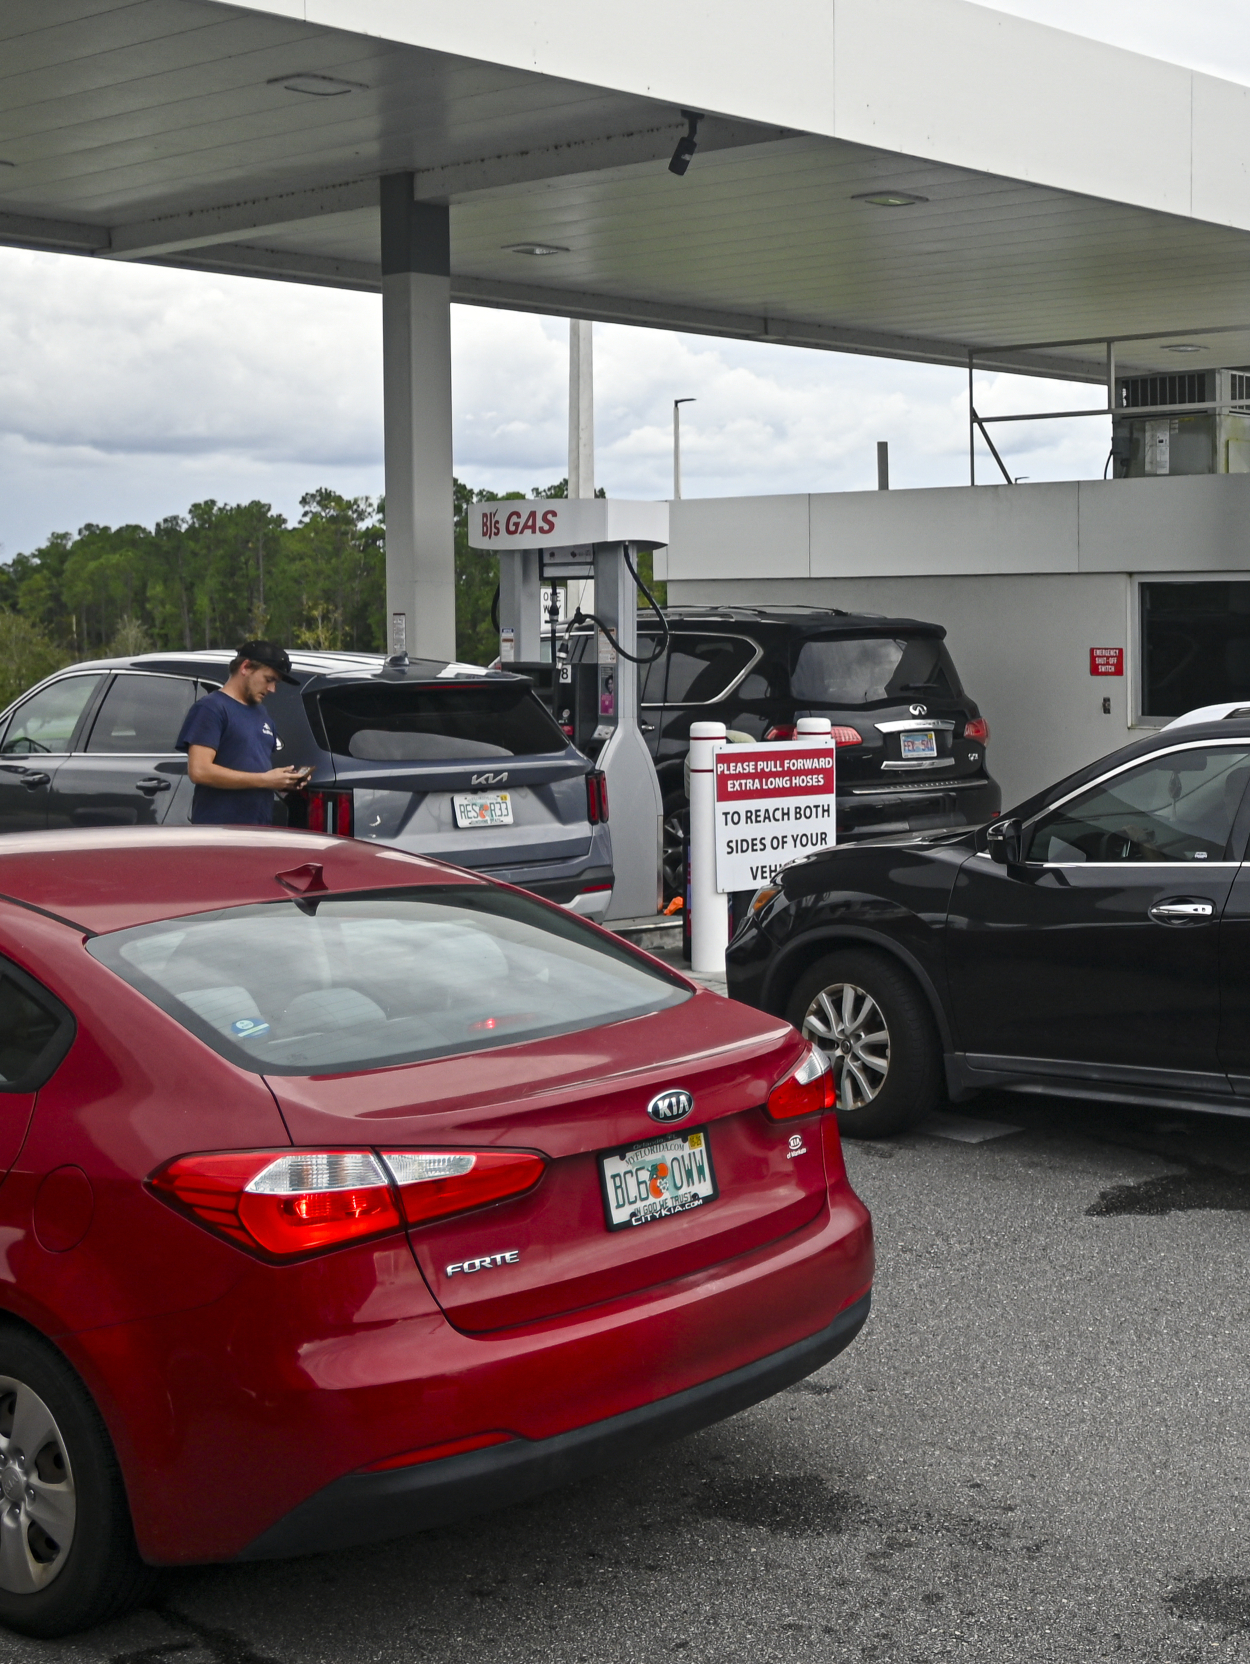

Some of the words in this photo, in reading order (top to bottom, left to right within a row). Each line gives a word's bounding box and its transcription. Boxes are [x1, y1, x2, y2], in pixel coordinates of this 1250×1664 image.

[482, 508, 500, 540] BJ's
[505, 509, 558, 535] GAS
[543, 591, 561, 601] OE
[1093, 648, 1119, 656] EMERGENCY
[561, 667, 569, 680] 8
[717, 762, 755, 775] PLEASE
[757, 760, 782, 772] PULL
[784, 757, 833, 771] FORWARD
[727, 778, 760, 792] EXTRA
[762, 777, 790, 789] LONG
[792, 774, 824, 787] HOSES
[459, 803, 479, 820] RES
[489, 801, 509, 817] R33
[722, 811, 741, 826] TO
[745, 807, 791, 825] REACH
[794, 803, 831, 821] BOTH
[726, 837, 766, 855] SIDES
[770, 835, 788, 850] OF
[791, 832, 828, 848] YOUR
[750, 863, 782, 881] VEH
[657, 1094, 690, 1119] KIA
[610, 1166, 650, 1210] BC6
[642, 1202, 658, 1216] GOD
[659, 1198, 669, 1210] WE
[671, 1191, 692, 1206] TRUST
[446, 1250, 520, 1277] FORTE
